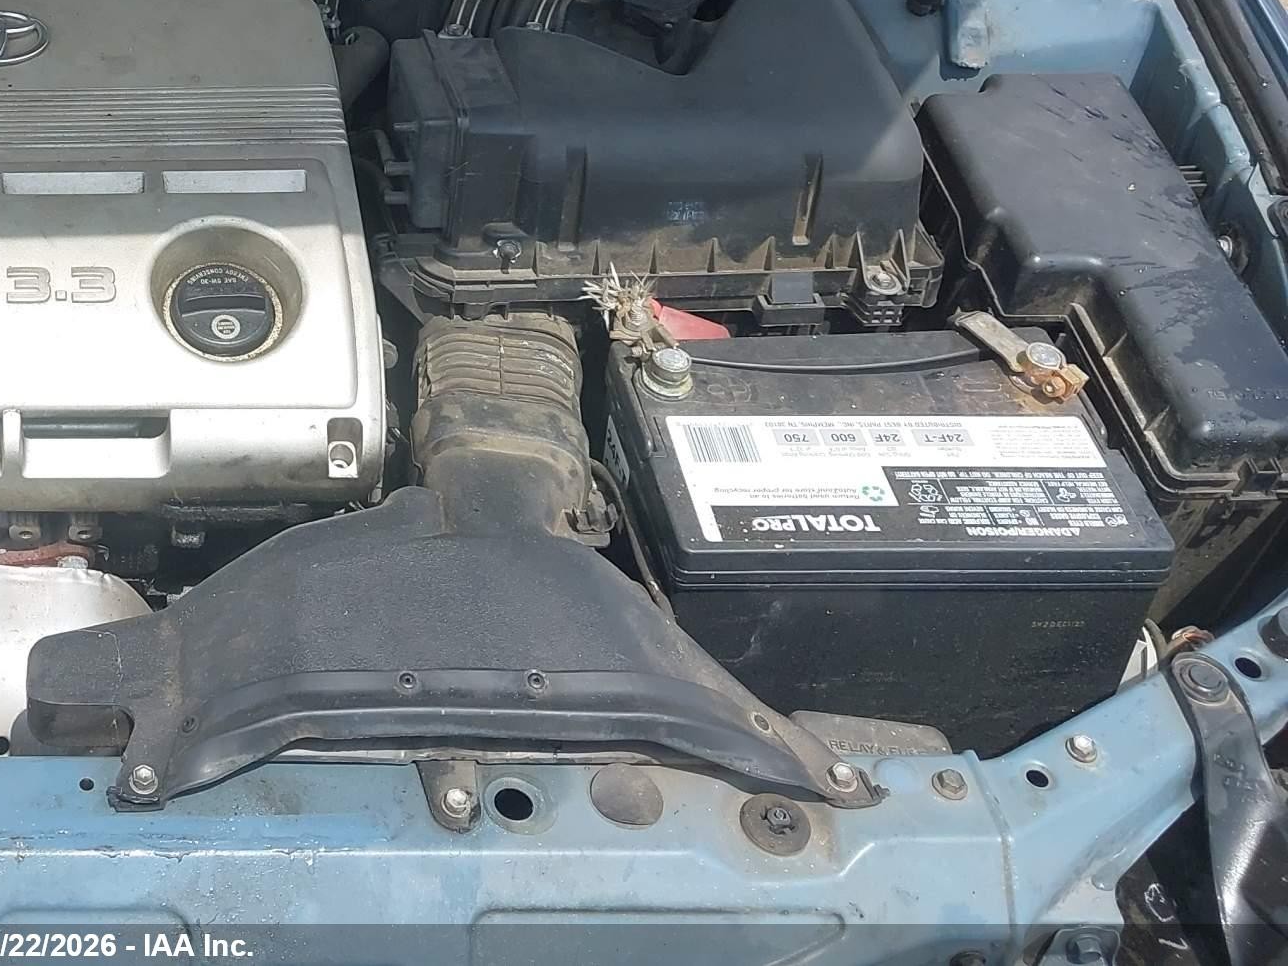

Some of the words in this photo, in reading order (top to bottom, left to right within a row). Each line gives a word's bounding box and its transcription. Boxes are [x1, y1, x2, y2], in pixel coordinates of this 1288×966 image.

[6, 265, 117, 304] 3.3
[784, 433, 809, 443] 750
[831, 433, 856, 443] 600
[874, 433, 900, 443] 24F
[924, 433, 963, 443] 24F-T
[752, 514, 881, 532] TOTALPRO
[829, 740, 874, 754] RELAY
